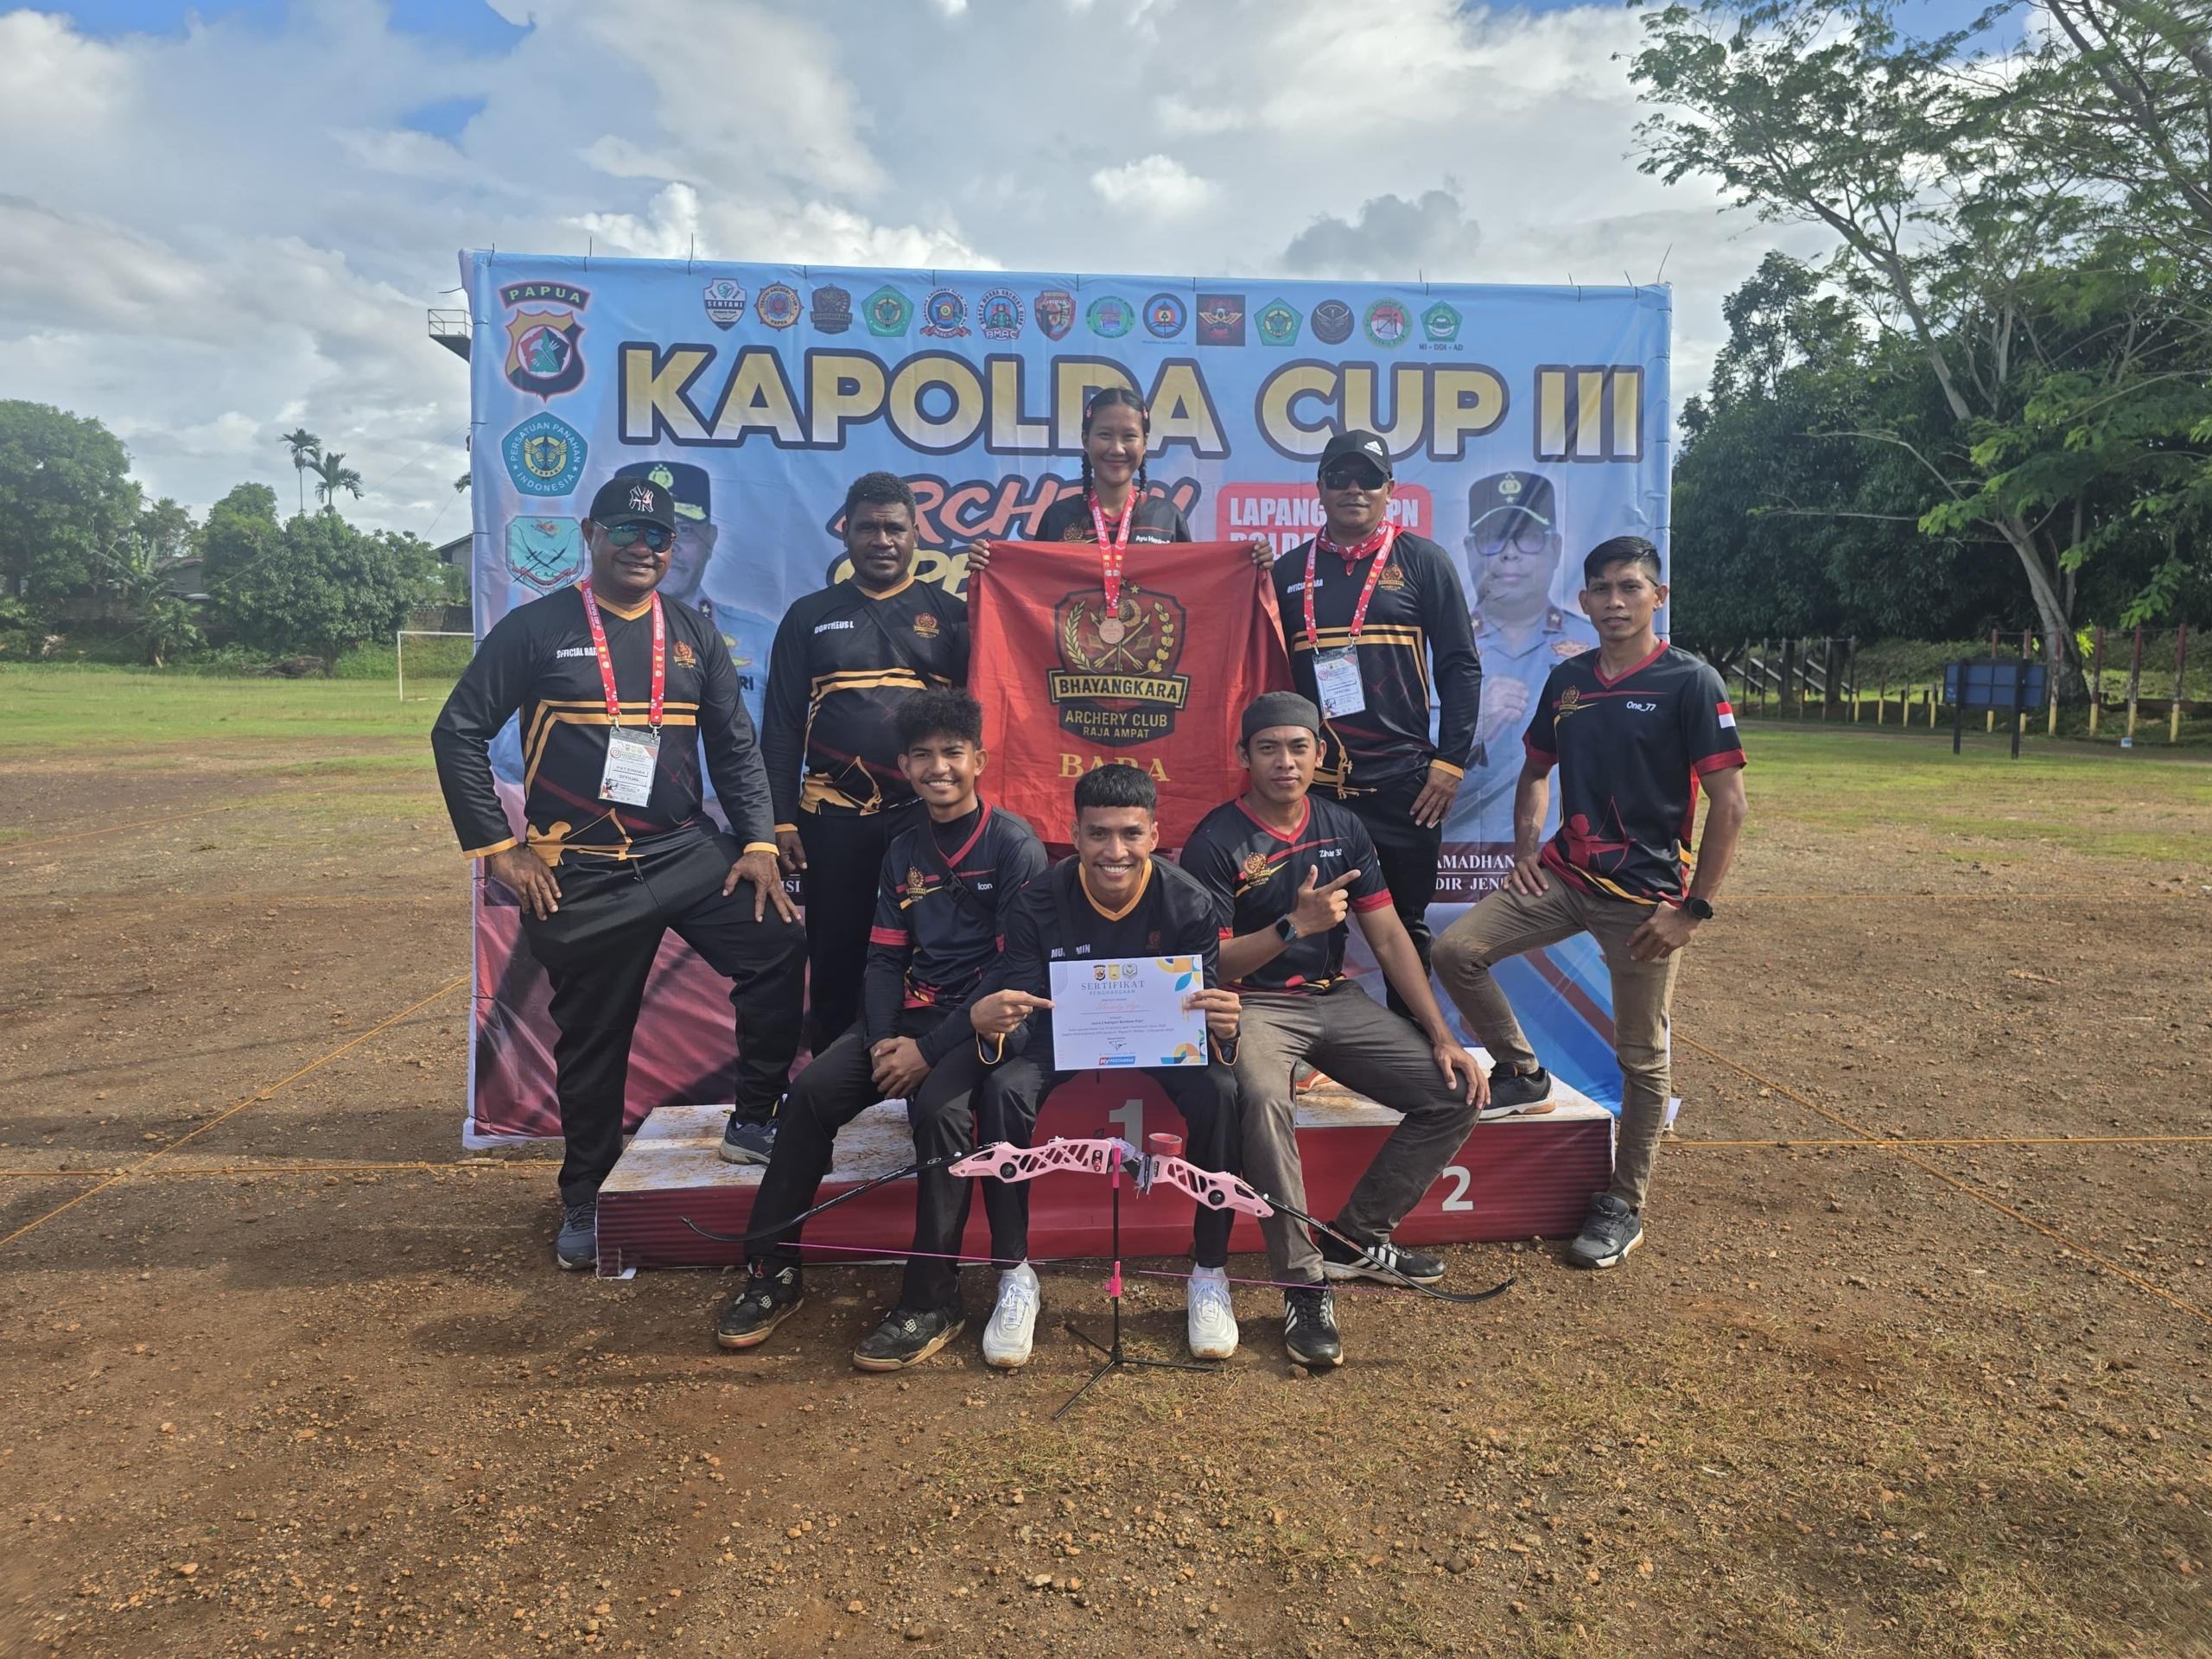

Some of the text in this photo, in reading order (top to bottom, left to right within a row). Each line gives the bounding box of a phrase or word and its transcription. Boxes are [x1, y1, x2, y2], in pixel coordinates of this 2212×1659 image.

[510, 286, 581, 303] PAPUA
[620, 343, 1642, 461] KAPOLDA CUP III
[511, 422, 582, 463] PERSATUAN PANAHAN
[516, 471, 575, 493] INDONESIA
[1230, 498, 1420, 527] LAPANG PN
[556, 647, 583, 658] OFFICIAL
[1059, 678, 1178, 699] BHAYANGKARA
[1626, 701, 1657, 712] One_77
[1065, 710, 1168, 727] ARCHERY CLUB
[1083, 726, 1149, 739] RAJA AMPAT
[977, 881, 993, 891] Icon
[1469, 877, 1503, 890] JEN
[1081, 980, 1145, 991] SERTIFIKAT
[1109, 1098, 1143, 1173] 1
[1441, 1165, 1473, 1211] 2
